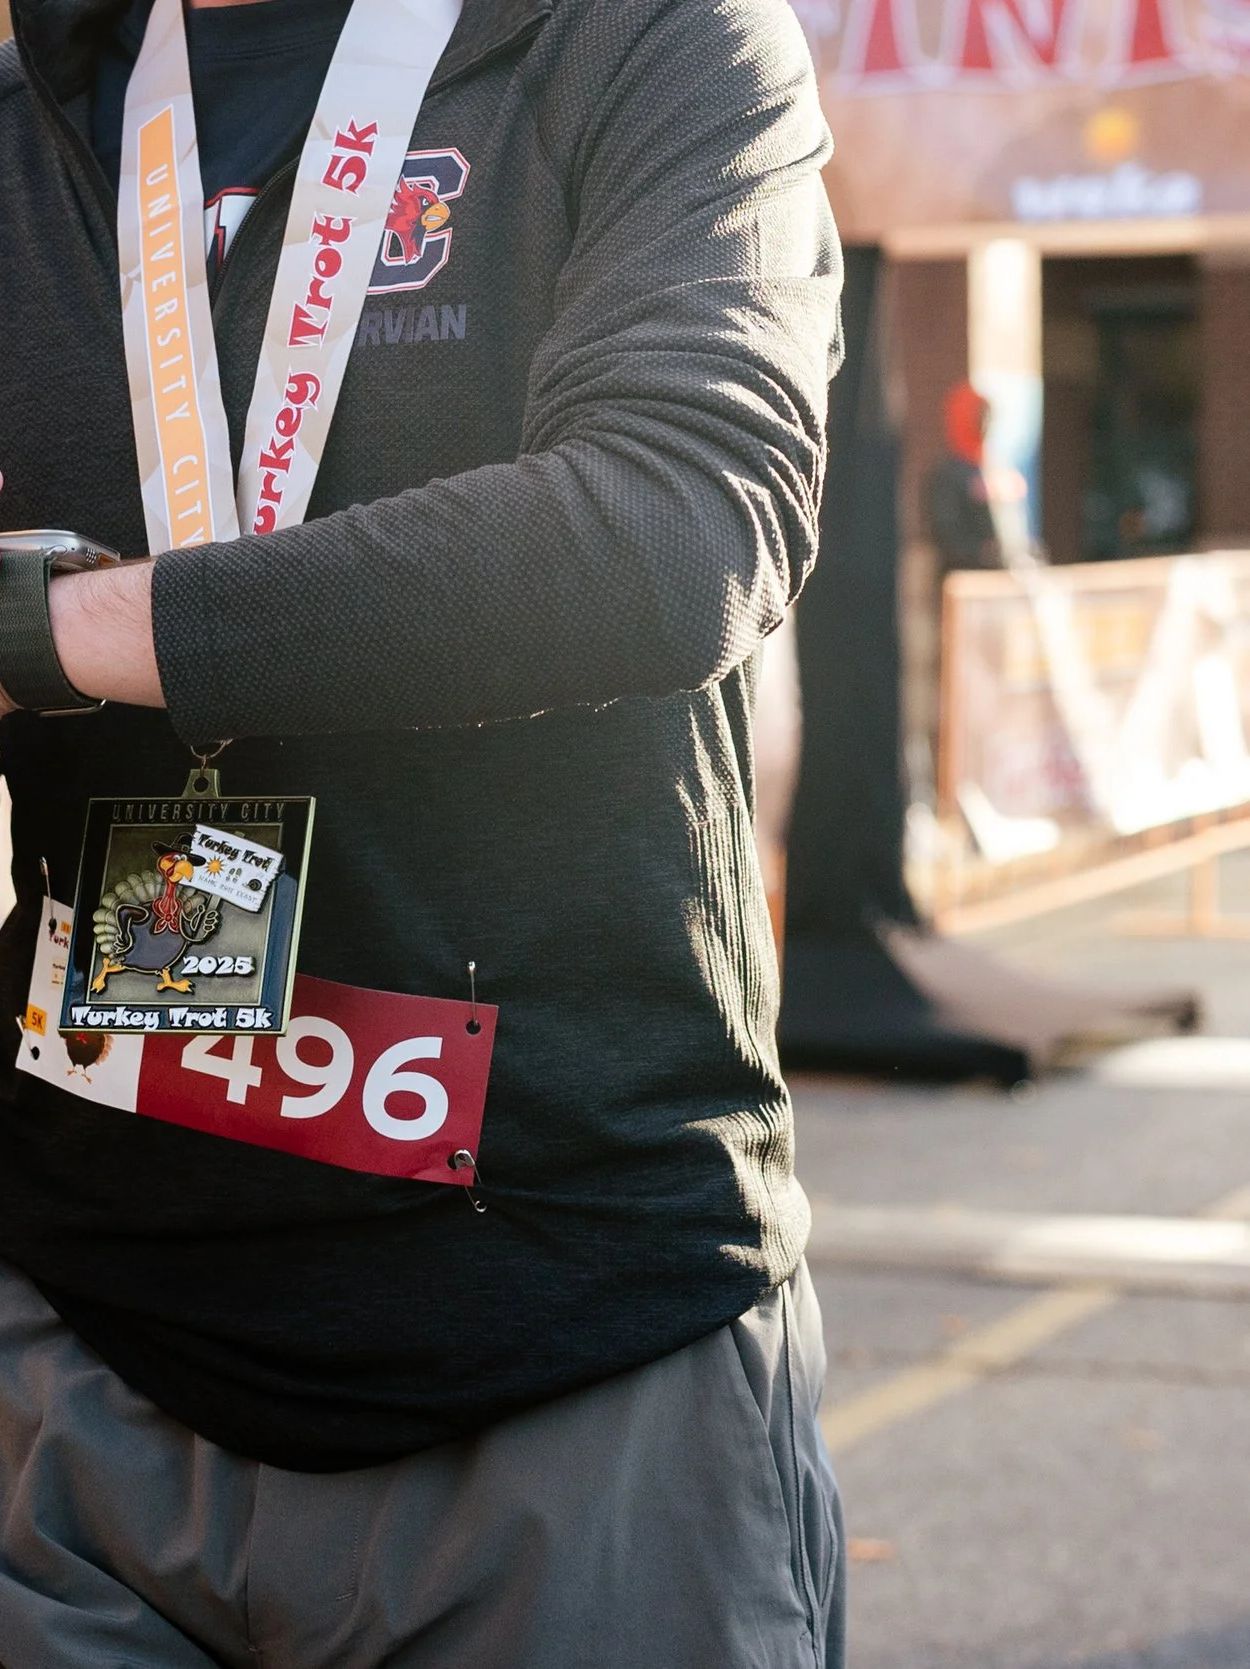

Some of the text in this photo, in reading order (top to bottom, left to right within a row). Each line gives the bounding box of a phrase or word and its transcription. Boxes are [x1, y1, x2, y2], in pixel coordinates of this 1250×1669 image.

[254, 116, 378, 536] urkey Trot 5k
[356, 304, 467, 347] RVIAN
[145, 164, 205, 547] UNIVERSITY CITY
[112, 803, 285, 820] UNIVERSITY CITY
[198, 833, 275, 872] Turkey Trot
[48, 931, 69, 949] Turk
[181, 956, 254, 975] 2025
[31, 1011, 44, 1029] 5K
[71, 1006, 272, 1030] Turkey Trot 5k
[181, 1016, 448, 1141] 496
